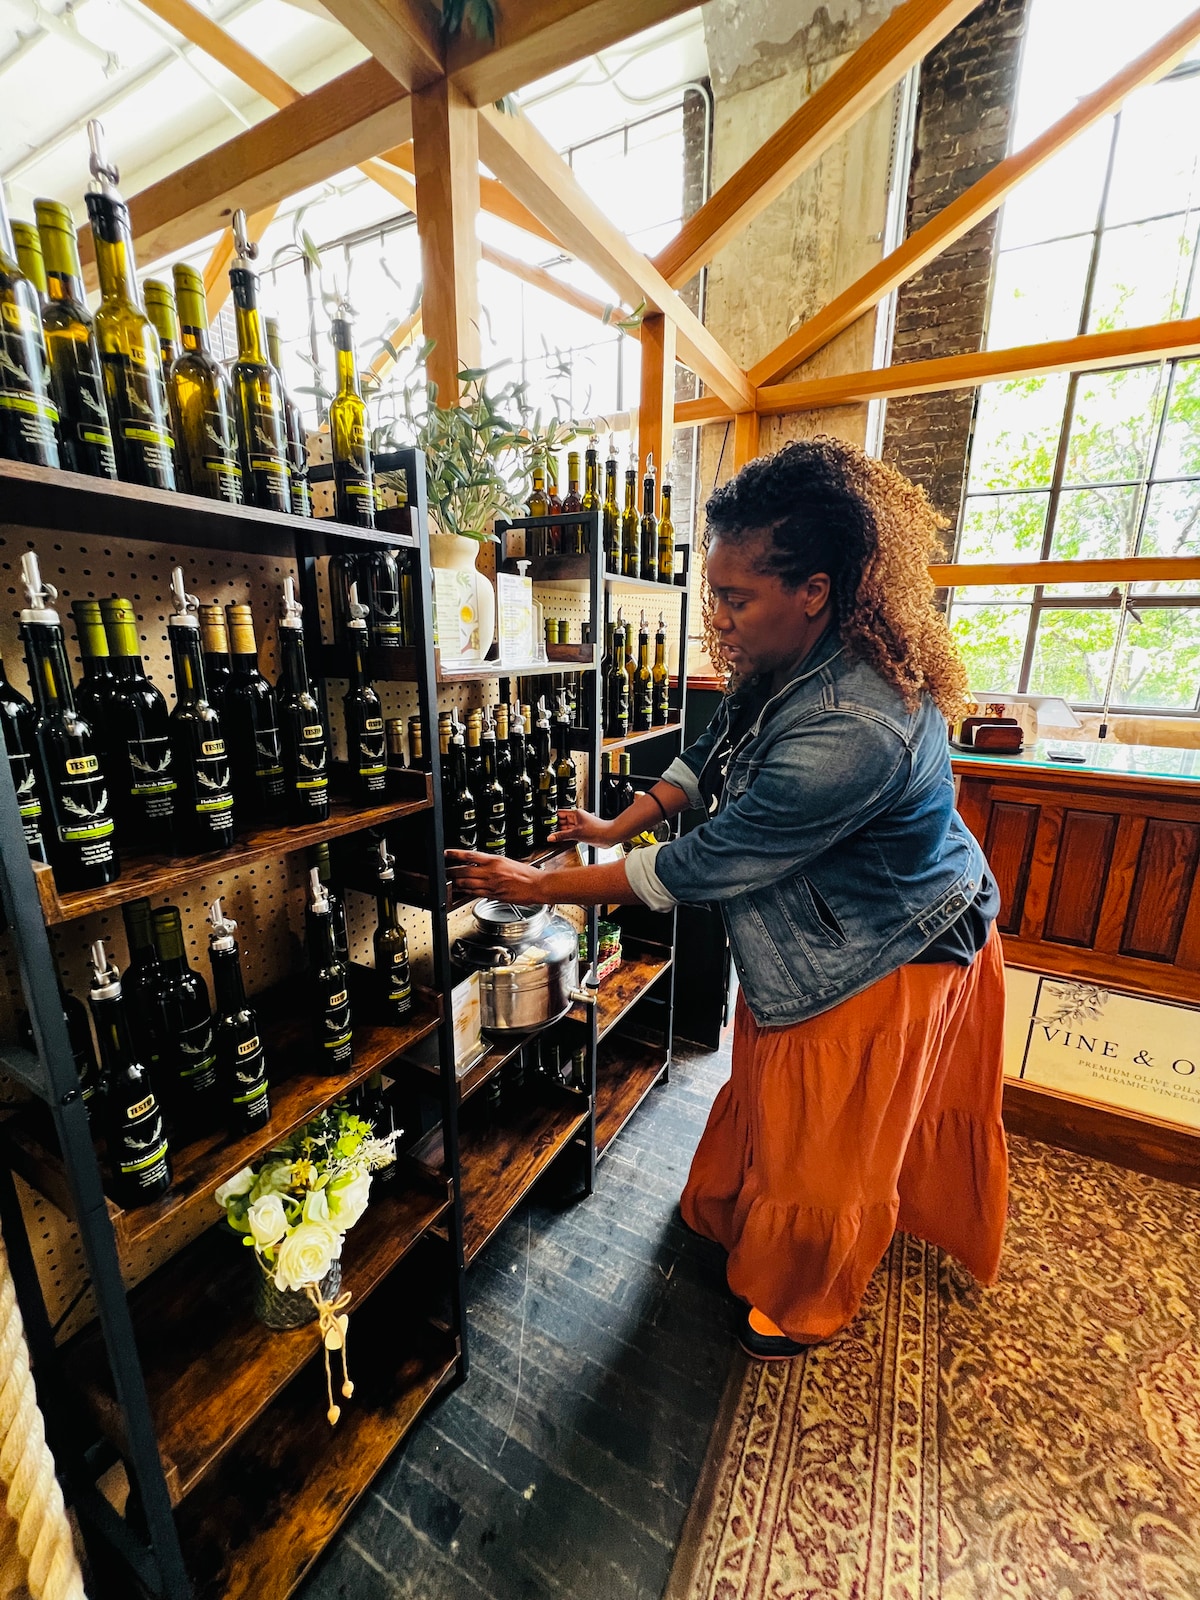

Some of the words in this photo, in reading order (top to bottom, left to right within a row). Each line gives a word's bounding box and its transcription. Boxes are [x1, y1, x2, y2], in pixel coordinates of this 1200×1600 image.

[1042, 1026, 1119, 1059] VINE
[1133, 1049, 1155, 1068] &
[1078, 1059, 1131, 1078] PREMIUM
[1134, 1074, 1170, 1088] OLIVE
[1091, 1071, 1149, 1091] BALSAMIC
